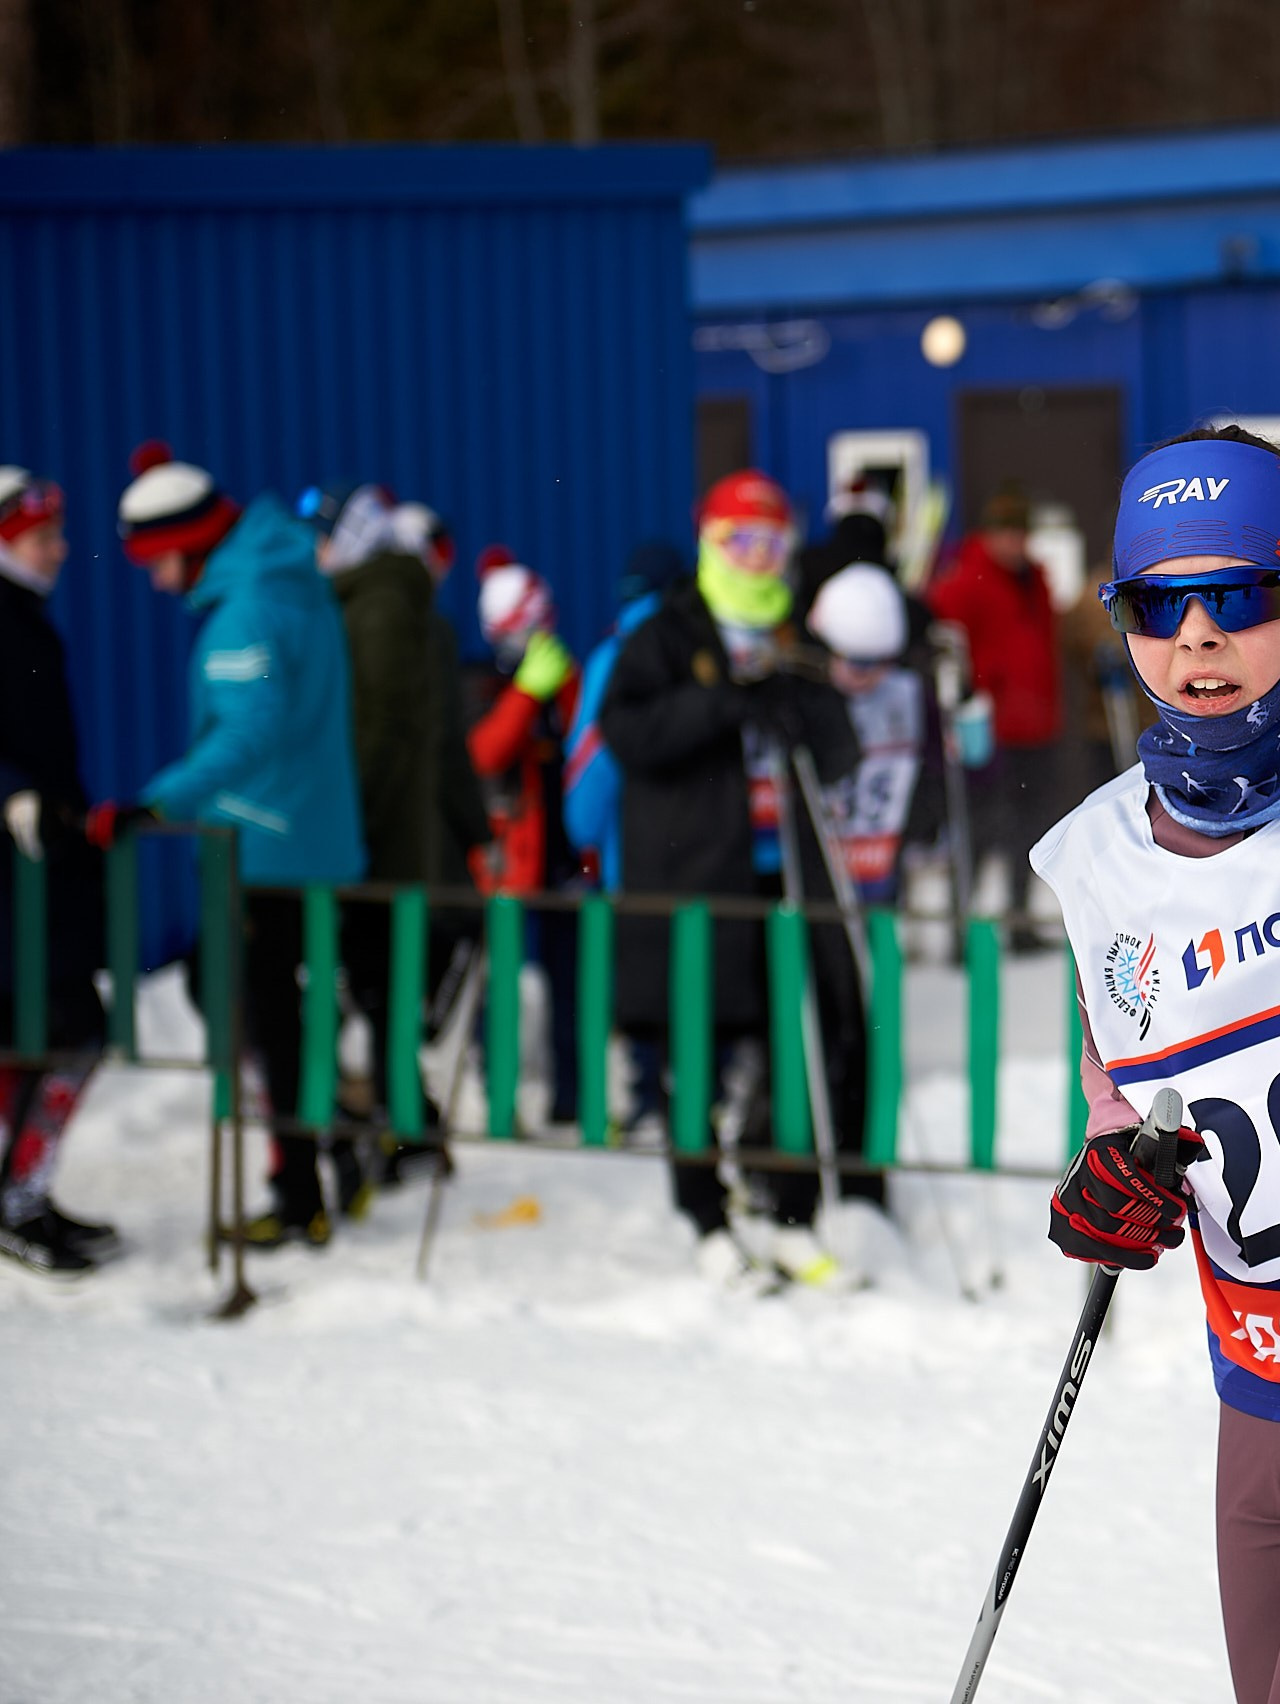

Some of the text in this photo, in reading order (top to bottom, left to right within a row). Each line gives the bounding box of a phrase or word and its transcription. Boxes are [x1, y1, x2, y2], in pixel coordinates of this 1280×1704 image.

[1138, 477, 1230, 509] RAY
[1104, 967, 1137, 1017] ФЕДЕРАЦИЯ
[1107, 1145, 1164, 1208] WIND PROOF
